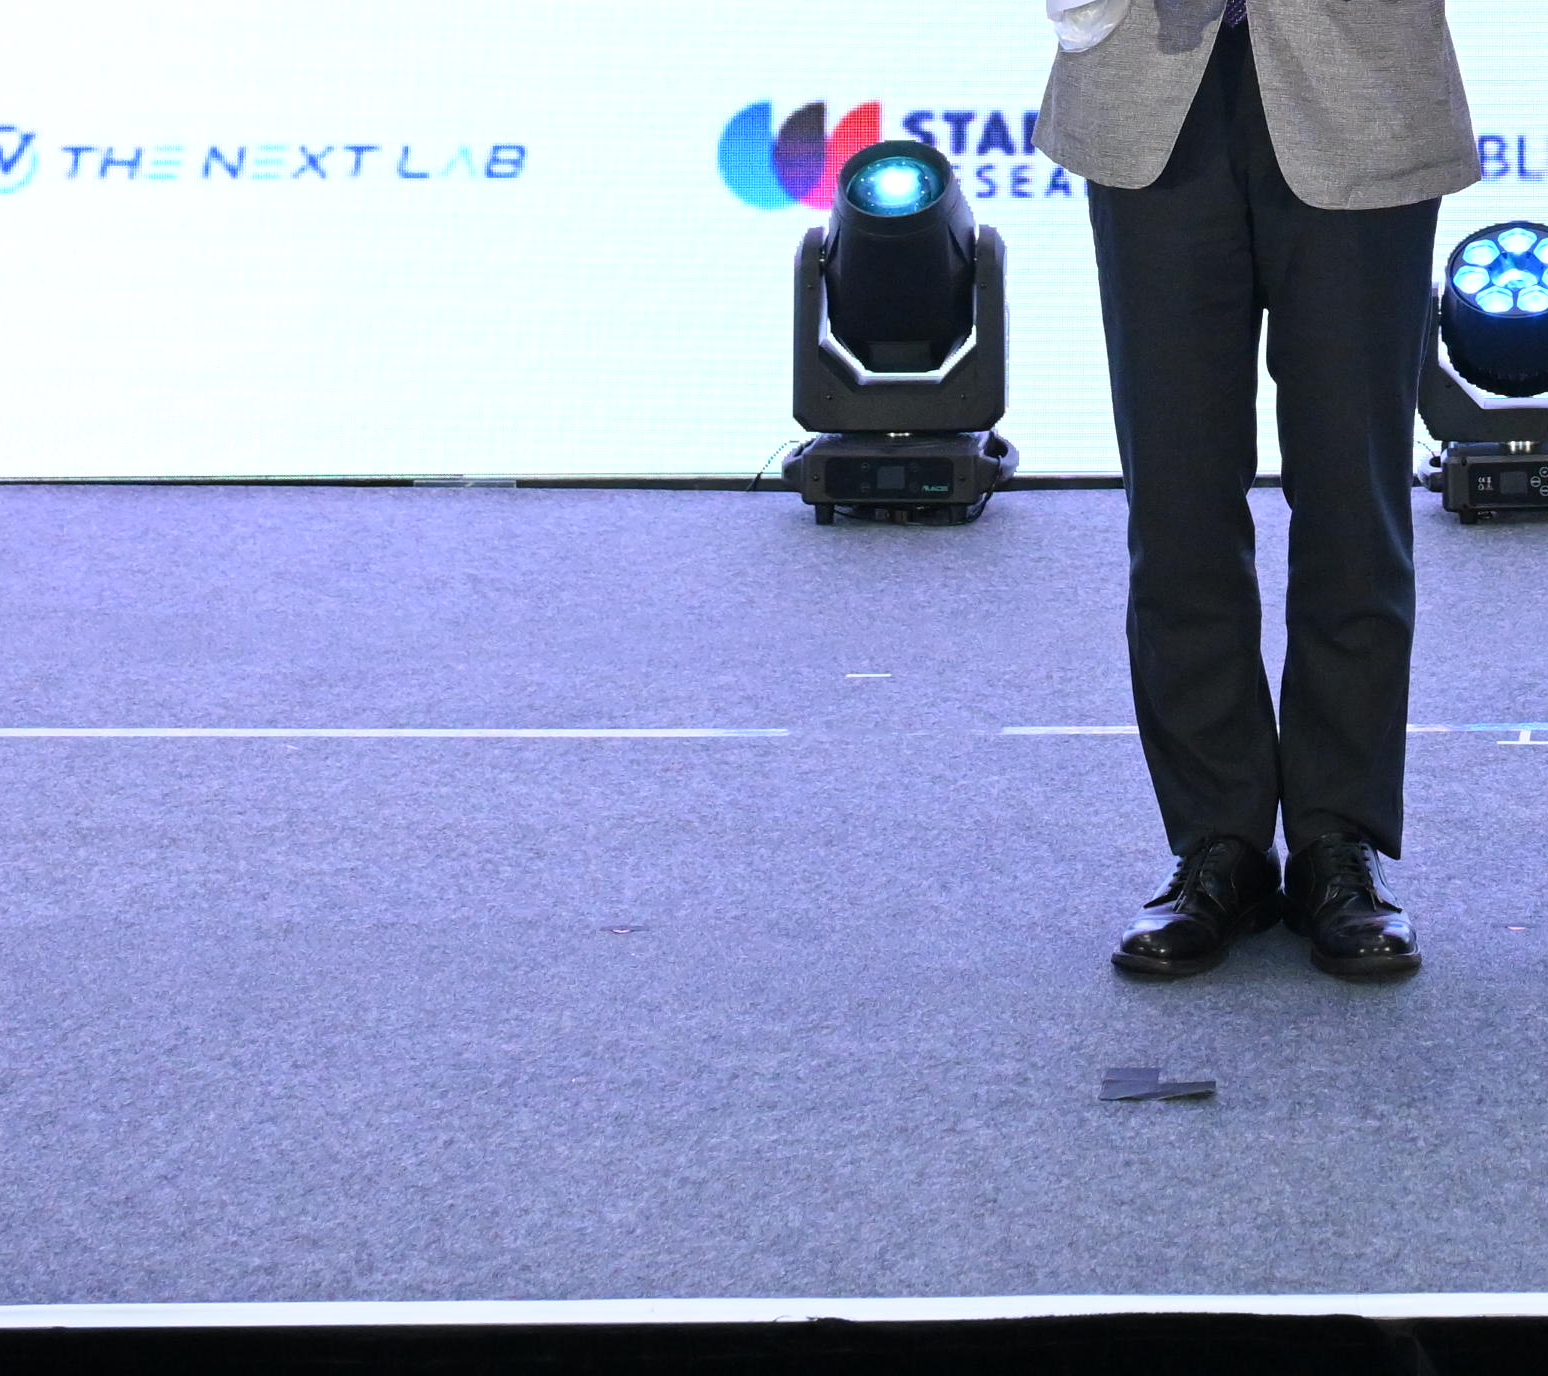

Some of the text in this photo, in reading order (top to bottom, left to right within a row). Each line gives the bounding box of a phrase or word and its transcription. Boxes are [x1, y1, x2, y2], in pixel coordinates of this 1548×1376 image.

[56, 140, 530, 184] THE NEXT LAB
